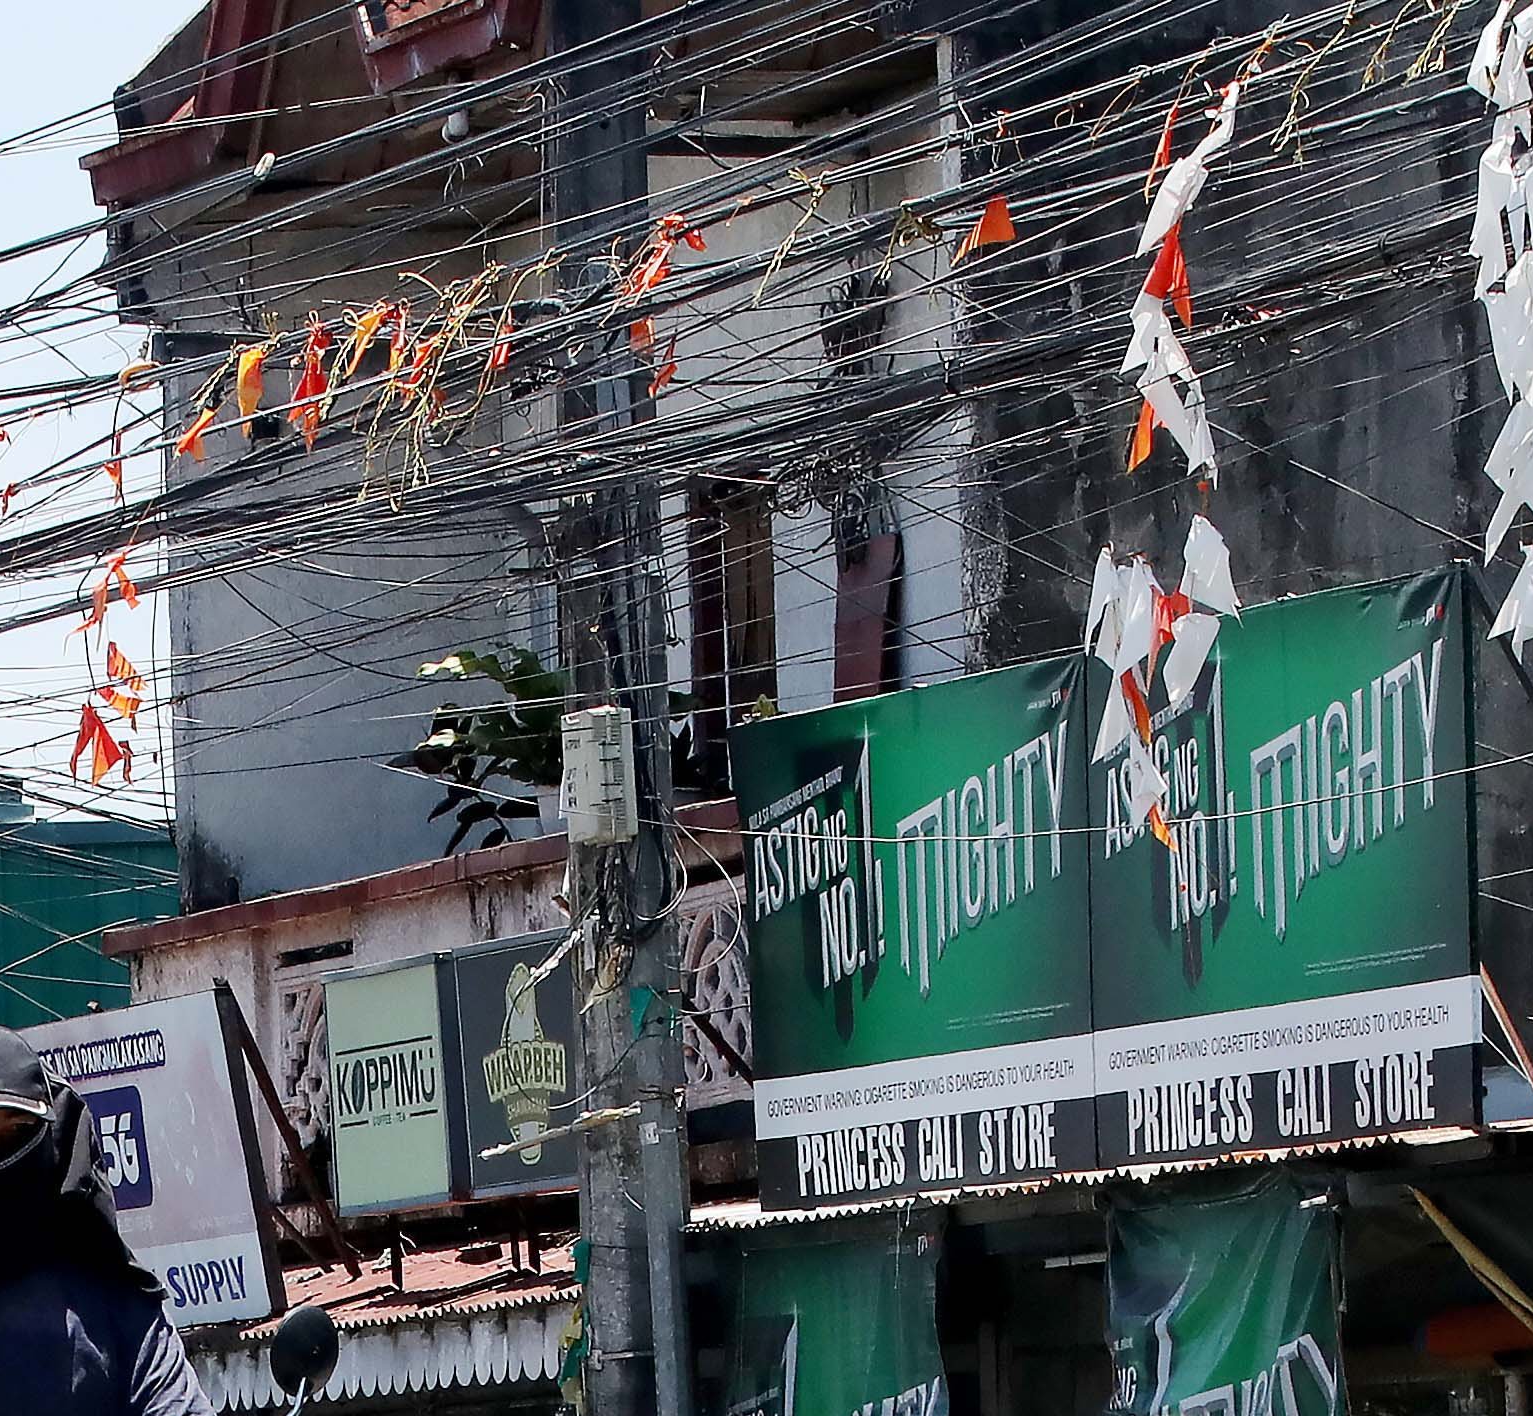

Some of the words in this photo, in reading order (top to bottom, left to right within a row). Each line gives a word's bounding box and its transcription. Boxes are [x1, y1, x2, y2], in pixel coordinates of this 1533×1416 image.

[1173, 738, 1199, 816] NG
[1249, 638, 1444, 944] MIGHTY
[754, 806, 821, 923] ASTIG
[823, 808, 849, 881] NG
[896, 719, 1069, 1001] MIGHTY
[1108, 1044, 1166, 1071] GOVERNMENT
[1210, 1031, 1261, 1057] CIGARETTE
[1262, 1024, 1304, 1049] SMOKING
[1304, 1022, 1314, 1043] IS
[1315, 1015, 1372, 1042] DANGEROUS
[1372, 1013, 1385, 1035] TO
[1385, 1008, 1413, 1032] YOUR
[1414, 1004, 1450, 1028] HEALTH
[767, 1093, 824, 1119] GOVERNMENT
[864, 1080, 907, 1105] CIGARETTE
[908, 1074, 945, 1099] SMOKING
[945, 1072, 955, 1095] IS
[955, 1066, 1006, 1093] DANGEROUS
[1006, 1064, 1019, 1087] TO
[1019, 1060, 1043, 1085] YOUR
[1043, 1058, 1074, 1081] HEALTH
[1126, 1073, 1254, 1157] PRINCESS
[1275, 1063, 1332, 1138] CALI
[1354, 1049, 1435, 1129] STORE
[99, 1112, 140, 1188] 5G
[796, 1122, 907, 1197] PRINCESS
[917, 1113, 965, 1183] CALI
[978, 1102, 1057, 1176] STORE
[166, 1254, 245, 1309] SUPPLY
